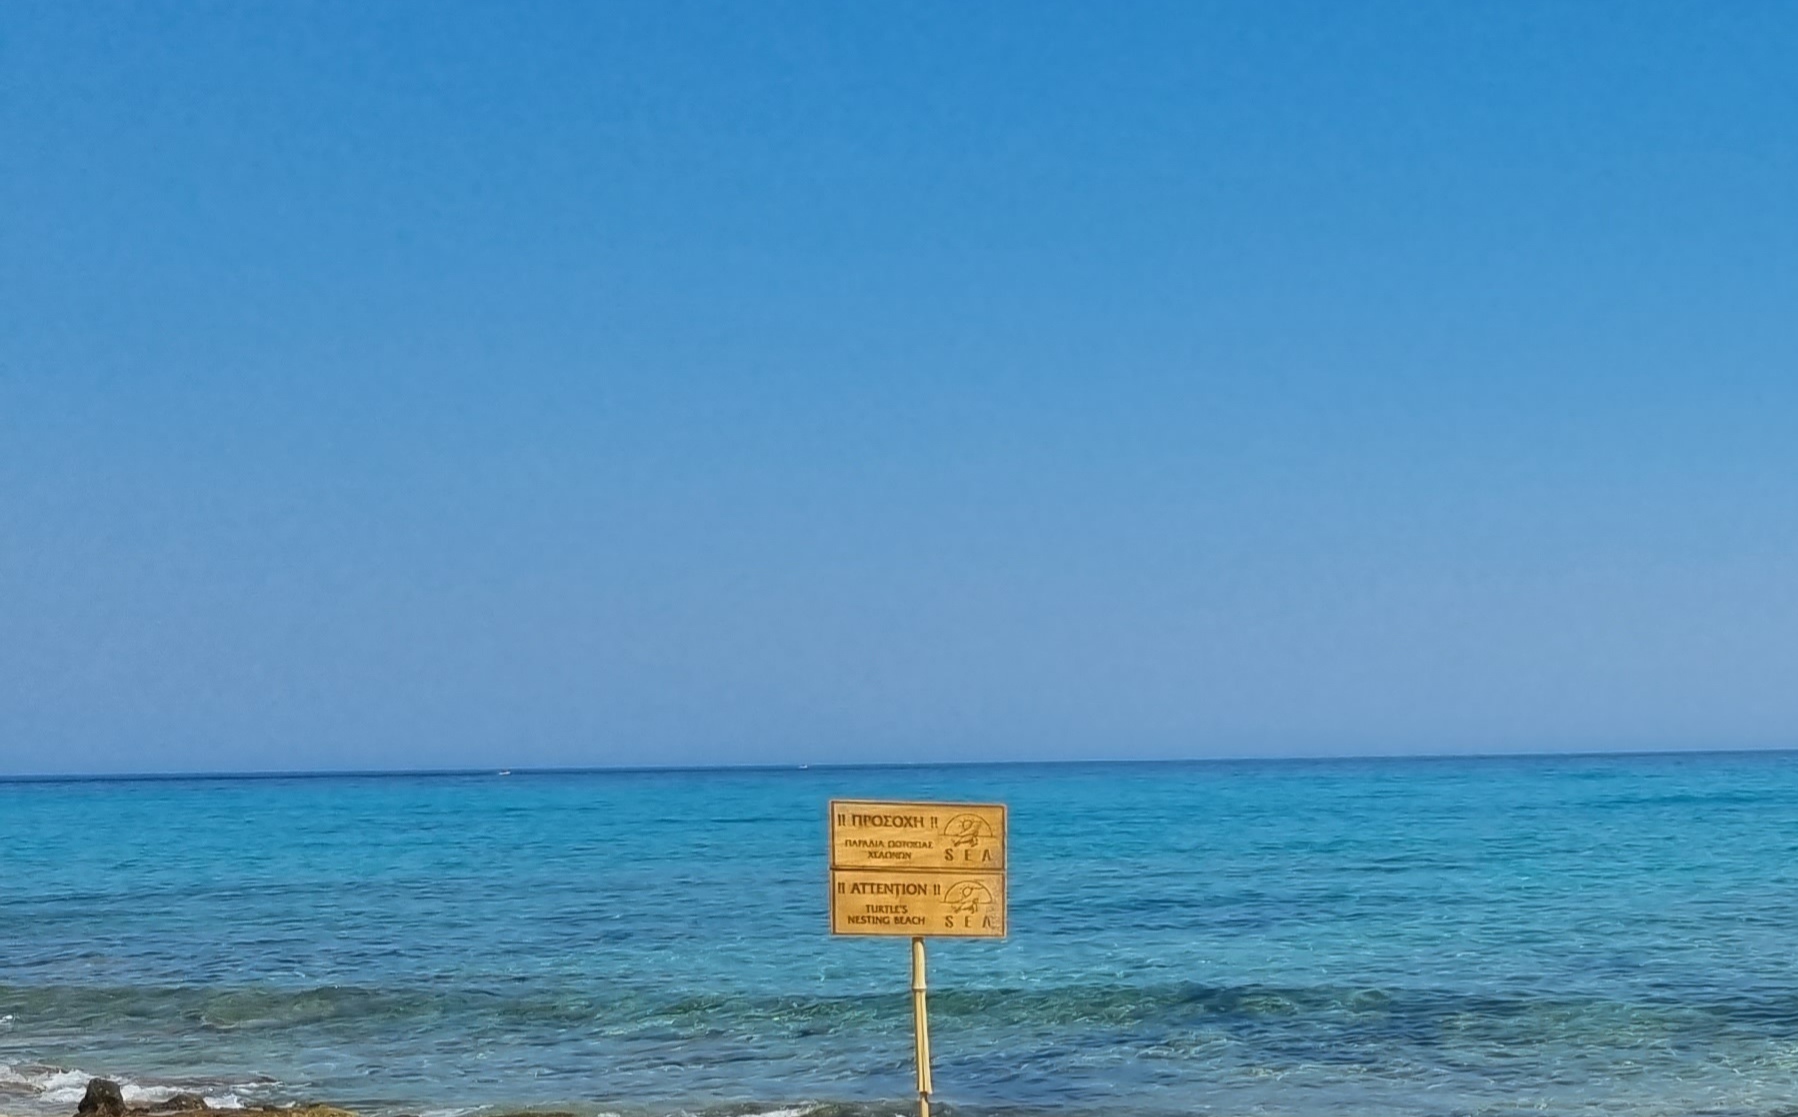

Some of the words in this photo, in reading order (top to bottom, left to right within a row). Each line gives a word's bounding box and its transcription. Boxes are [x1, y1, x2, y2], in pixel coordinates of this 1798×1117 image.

[852, 814, 924, 828] ΠΡΟΣΟΧΗ
[850, 882, 928, 897] ATTENTION
[865, 904, 908, 914] TURTLE'S
[848, 915, 890, 925] NESTING
[894, 916, 926, 925] BEACH
